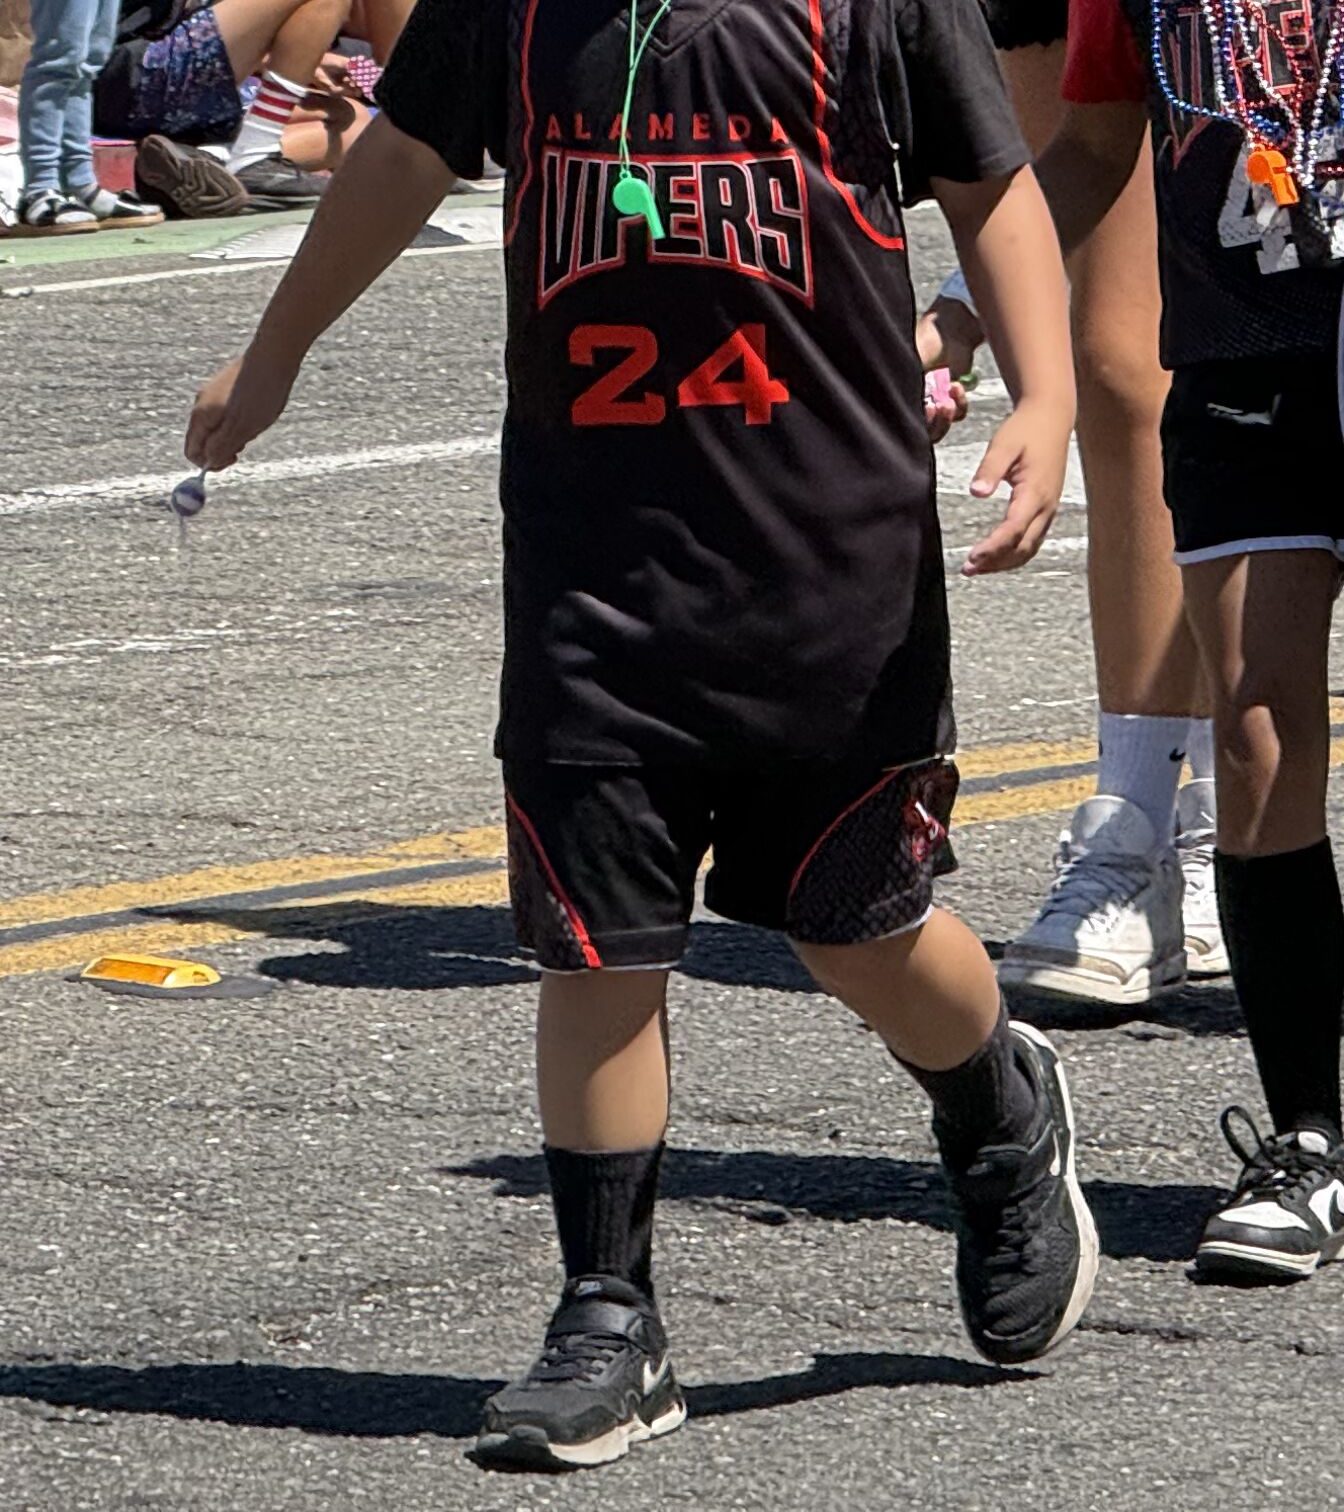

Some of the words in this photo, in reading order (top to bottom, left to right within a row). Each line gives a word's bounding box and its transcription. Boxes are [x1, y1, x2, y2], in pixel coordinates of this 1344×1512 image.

[545, 112, 791, 144] ALAMEDA
[538, 145, 815, 310] VIPERS
[567, 322, 791, 427] 24
